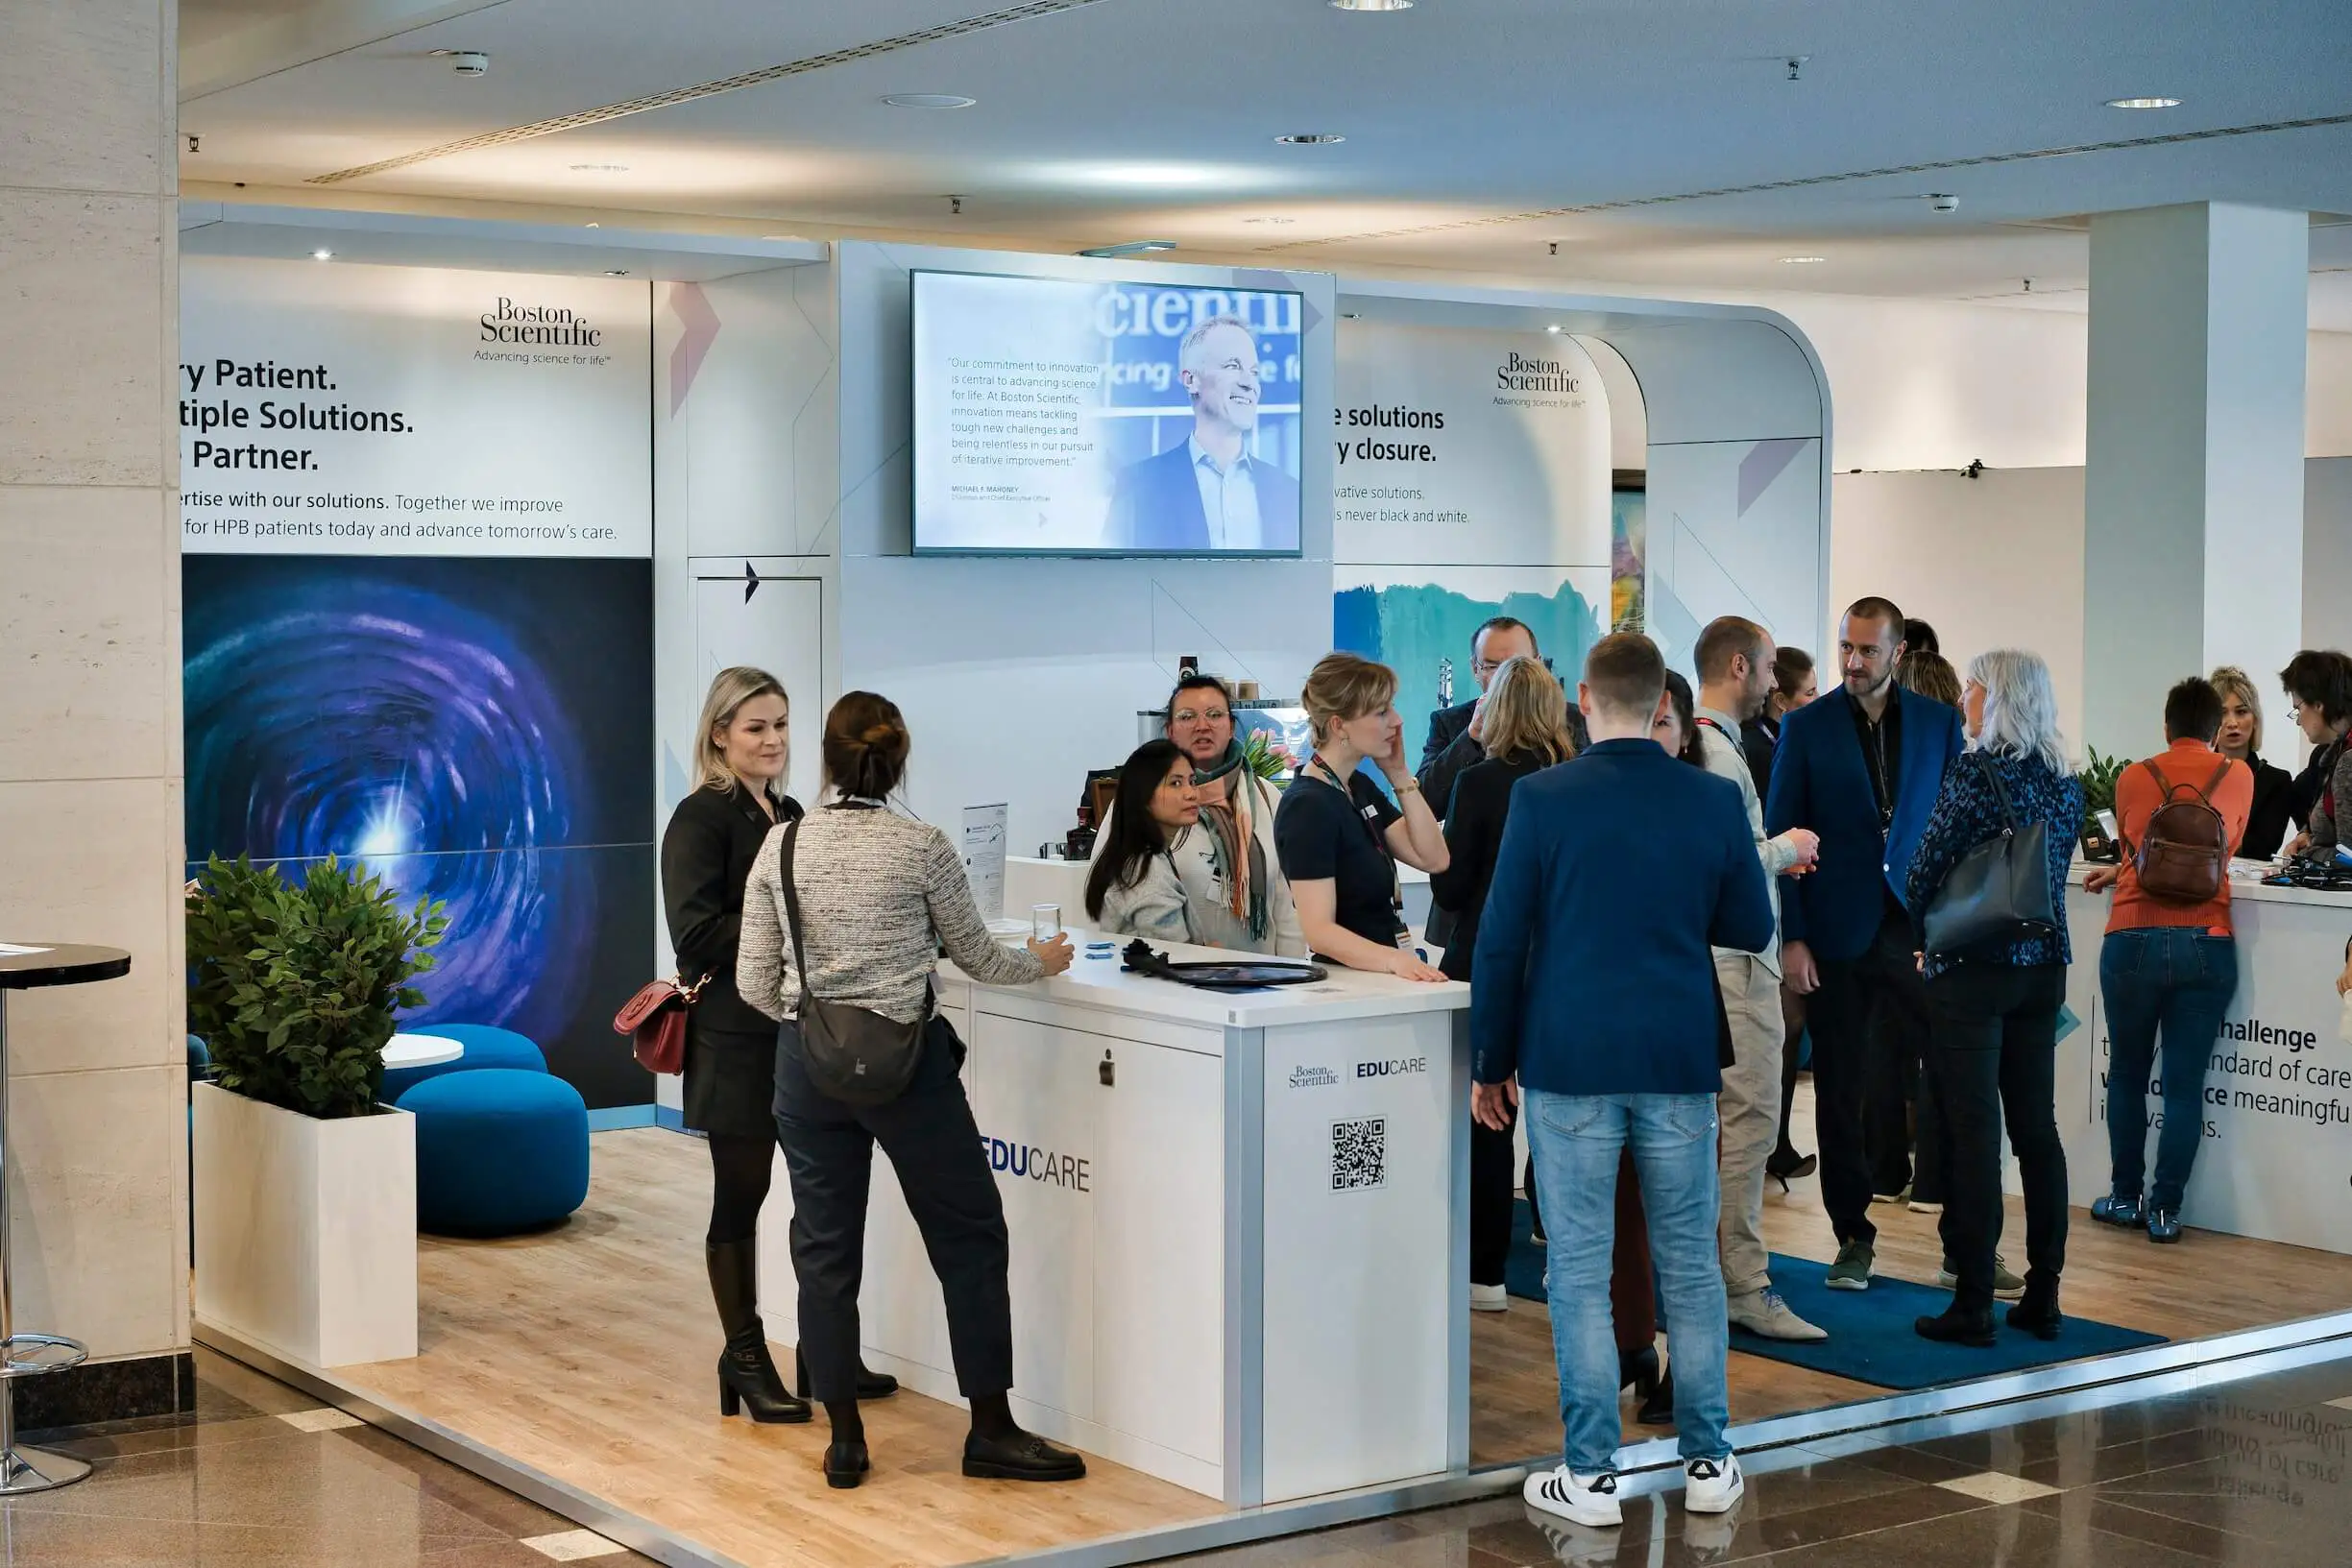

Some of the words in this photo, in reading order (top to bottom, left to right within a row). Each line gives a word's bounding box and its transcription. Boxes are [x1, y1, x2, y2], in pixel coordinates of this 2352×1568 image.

[497, 297, 573, 324] Boston
[480, 313, 601, 347] Scientific
[473, 350, 529, 365] Advancing
[533, 353, 570, 364] science
[572, 353, 587, 365] for
[972, 360, 1034, 372] commitment
[1036, 362, 1047, 373] to
[1049, 362, 1100, 374] innovation
[1508, 351, 1560, 374] Boston
[215, 358, 336, 390] Patient.
[952, 375, 959, 385] is
[961, 374, 995, 385] central
[997, 375, 1007, 386] to
[1009, 376, 1059, 390] advancing
[1061, 379, 1097, 390] science
[1497, 366, 1579, 393] Scientific
[952, 390, 965, 400] for
[986, 391, 999, 401] At
[1001, 392, 1034, 403] Boston
[1492, 397, 1530, 408] Advancing
[1533, 398, 1559, 407] science
[1560, 399, 1569, 408] for
[180, 398, 249, 434] tiple
[259, 401, 413, 433] Solutions.
[952, 406, 1004, 418] innovation
[1006, 409, 1038, 420] means
[1040, 409, 1078, 422] tackling
[1348, 404, 1444, 429] solutions
[952, 422, 981, 435] tough
[983, 425, 1004, 434] new
[1006, 424, 1057, 437] challenges
[1060, 425, 1079, 436] and
[194, 440, 318, 470] Partner.
[952, 437, 980, 450] being
[982, 439, 1029, 450] relentless
[1031, 440, 1039, 450] in
[1042, 442, 1057, 451] our
[1060, 441, 1093, 453] pursuit
[1335, 441, 1349, 465] y
[1356, 437, 1436, 461] closure.
[952, 453, 962, 465] of
[964, 454, 1004, 466] iterative
[952, 485, 979, 494] MICHAEL
[986, 485, 1019, 495] MAHONEY
[1334, 485, 1368, 498] vative
[229, 491, 267, 508] with
[273, 494, 302, 508] our
[306, 493, 389, 509] solutions.
[395, 495, 467, 513] Together
[472, 497, 495, 511] we
[499, 495, 563, 515] improve
[1346, 509, 1377, 521] never
[1380, 508, 1409, 521] black
[1413, 510, 1433, 522] and
[184, 519, 208, 535] for
[214, 519, 249, 535] HPB
[255, 519, 323, 538] patients
[328, 520, 375, 540] today
[379, 521, 410, 537] and
[416, 522, 483, 538] advance
[488, 523, 577, 540] tomorrow's
[582, 526, 617, 540] care.
[2219, 1018, 2316, 1052] hallenge
[1297, 1065, 1327, 1076] Boston
[1357, 1057, 1426, 1077] EDUCARE
[2208, 1050, 2272, 1078] ndard
[2279, 1060, 2302, 1081] of
[2306, 1066, 2351, 1089] care
[1289, 1070, 1339, 1088] Scientific
[2234, 1090, 2350, 1124] meaningfu
